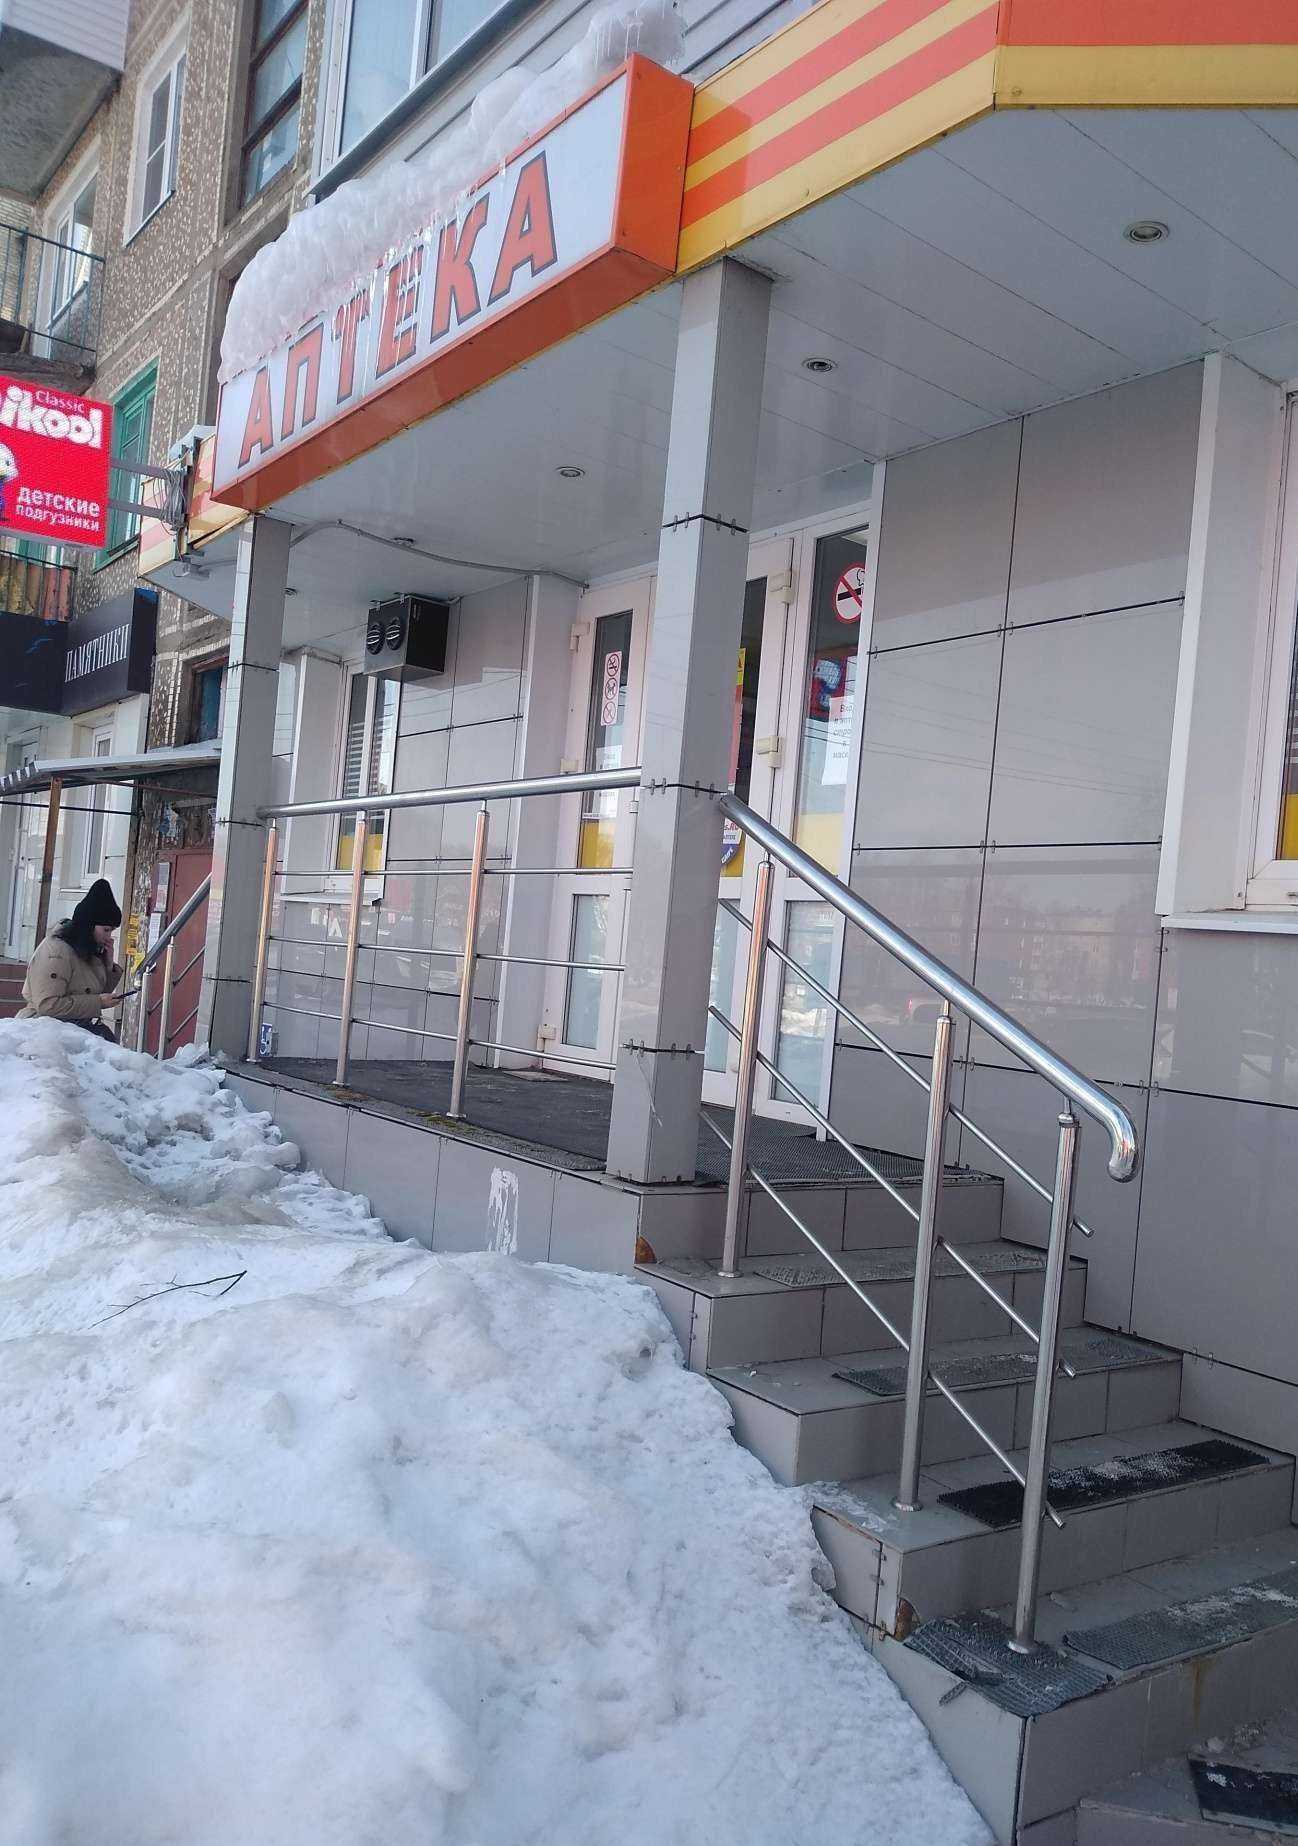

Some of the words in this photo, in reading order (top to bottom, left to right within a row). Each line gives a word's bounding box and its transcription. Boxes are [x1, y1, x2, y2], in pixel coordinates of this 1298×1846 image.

[238, 150, 558, 469] АПТЕКА
[35, 390, 85, 413] Classic
[17, 487, 101, 517] детские
[16, 504, 101, 532] подгузники
[64, 623, 130, 683] ПАМЯТНИКИ
